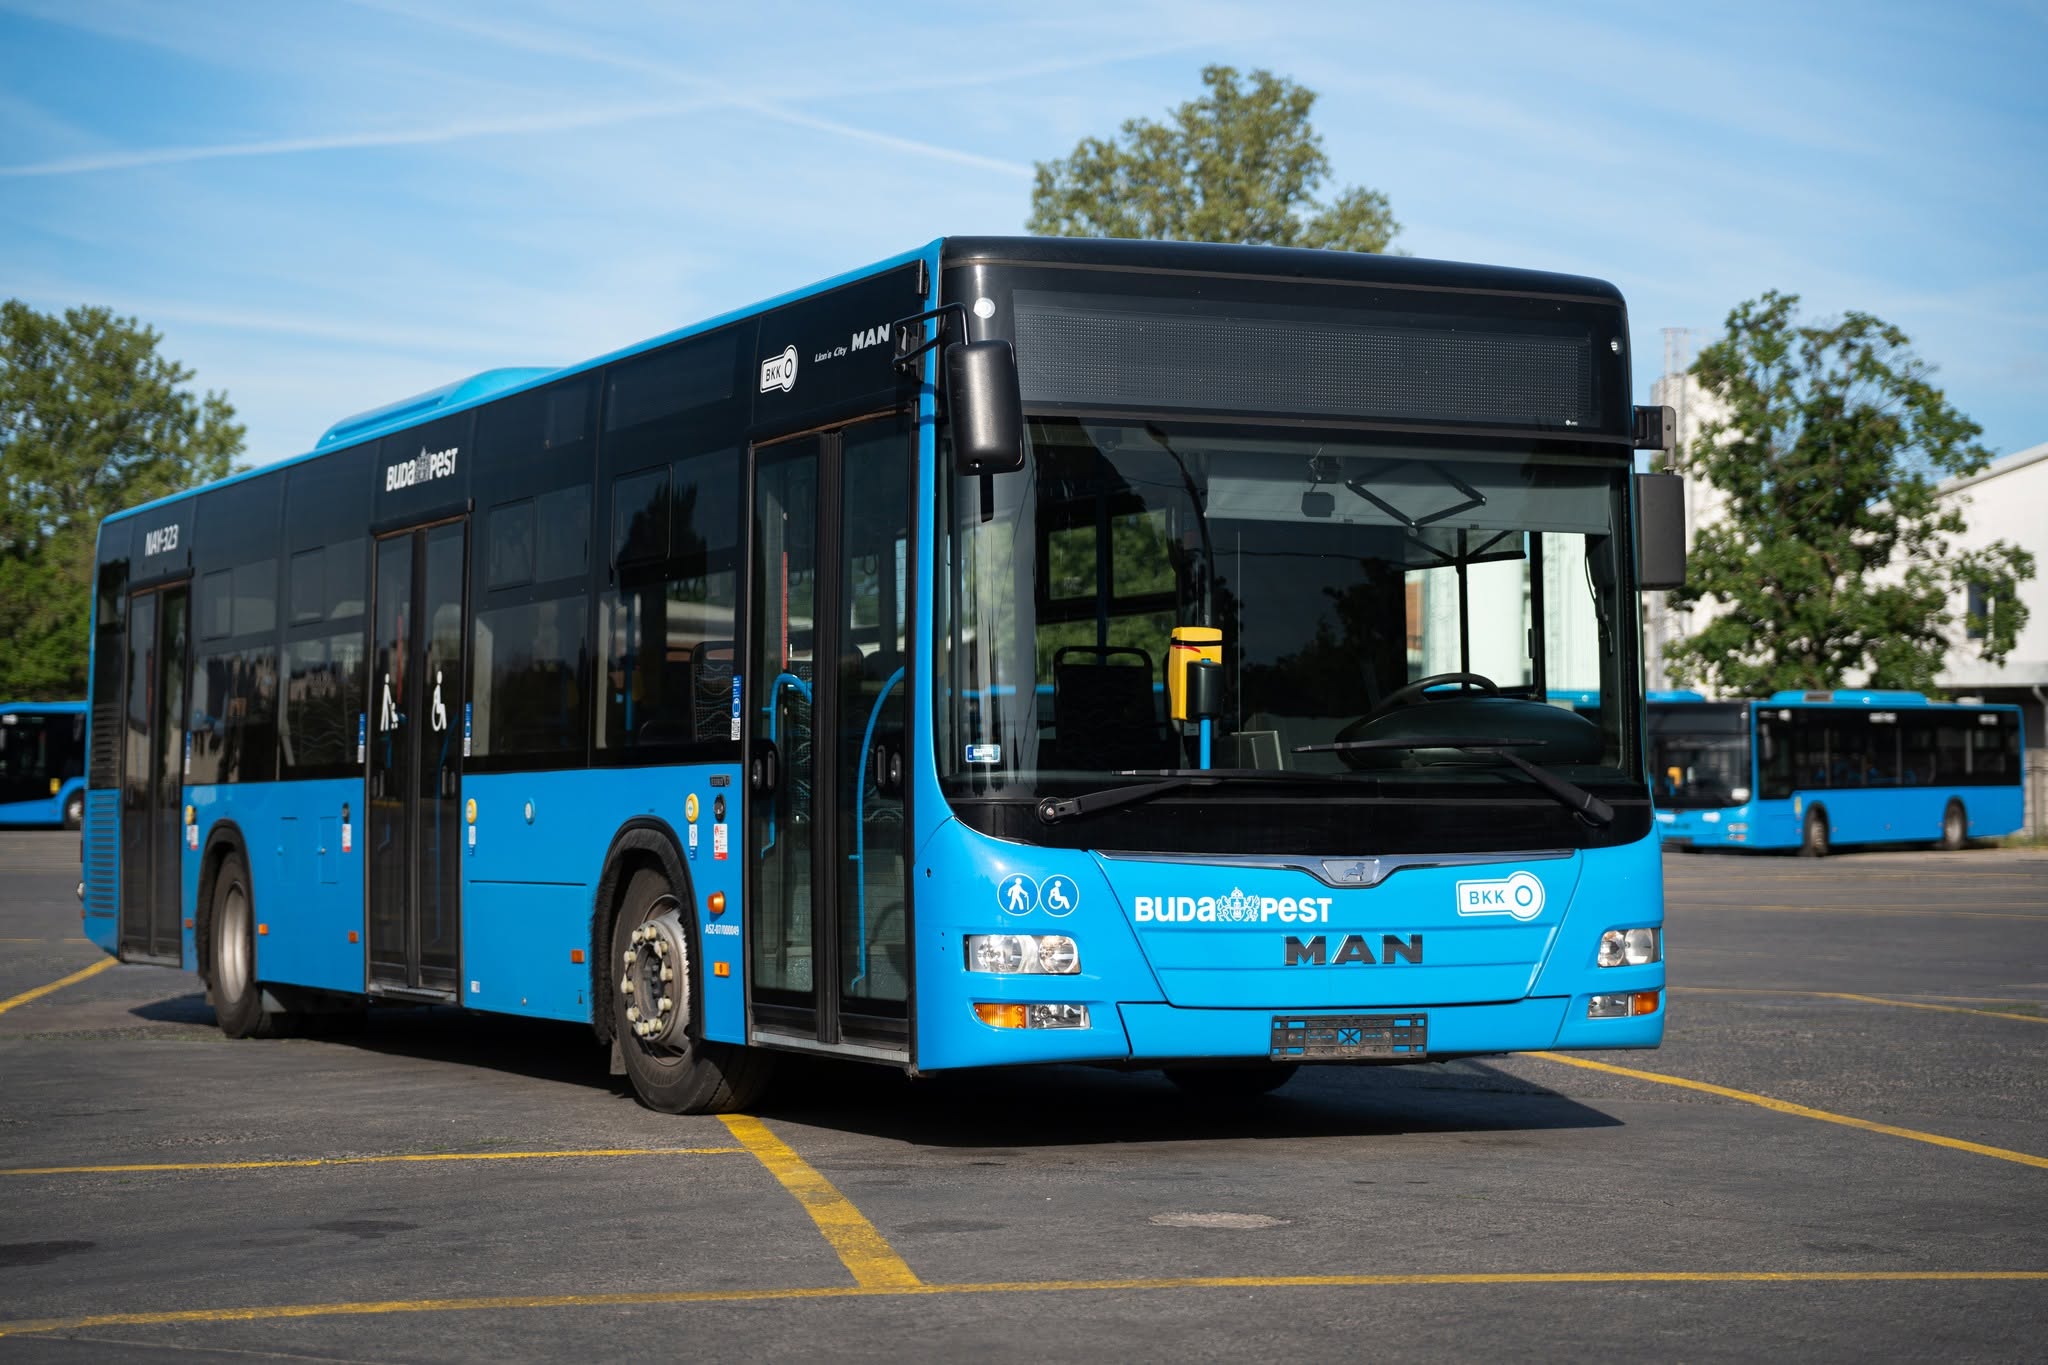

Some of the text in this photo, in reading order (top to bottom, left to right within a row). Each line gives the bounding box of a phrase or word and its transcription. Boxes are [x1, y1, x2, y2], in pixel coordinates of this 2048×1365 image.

[814, 323, 890, 362] Lion's City MAN
[1469, 889, 1505, 905] BKK
[1283, 933, 1423, 967] MAN
